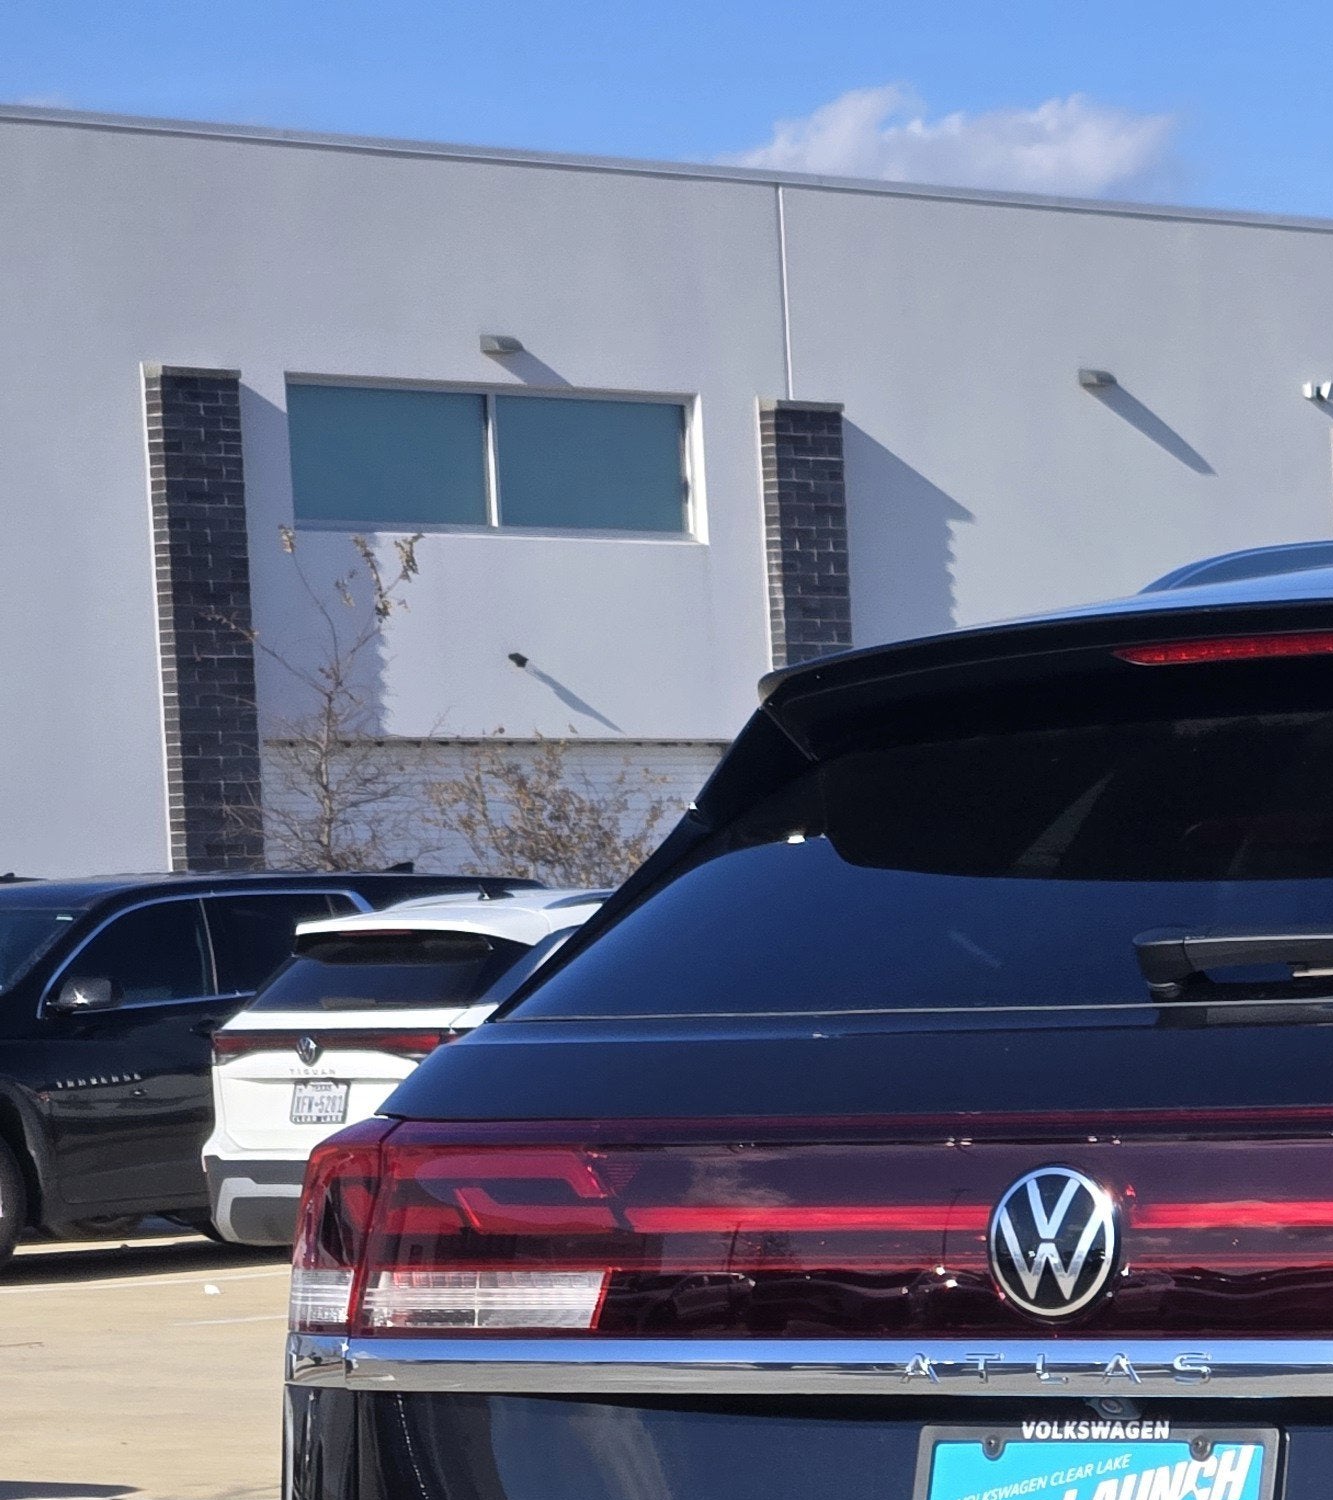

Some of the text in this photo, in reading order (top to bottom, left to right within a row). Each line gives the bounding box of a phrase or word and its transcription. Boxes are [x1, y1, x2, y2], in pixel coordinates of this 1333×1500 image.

[995, 1170, 1113, 1310] VW
[901, 1352, 1214, 1385] ATLAS
[1021, 1420, 1170, 1440] VOLKSWAGEN
[1050, 1463, 1094, 1487] CLEAR
[1096, 1453, 1132, 1475] LAKE
